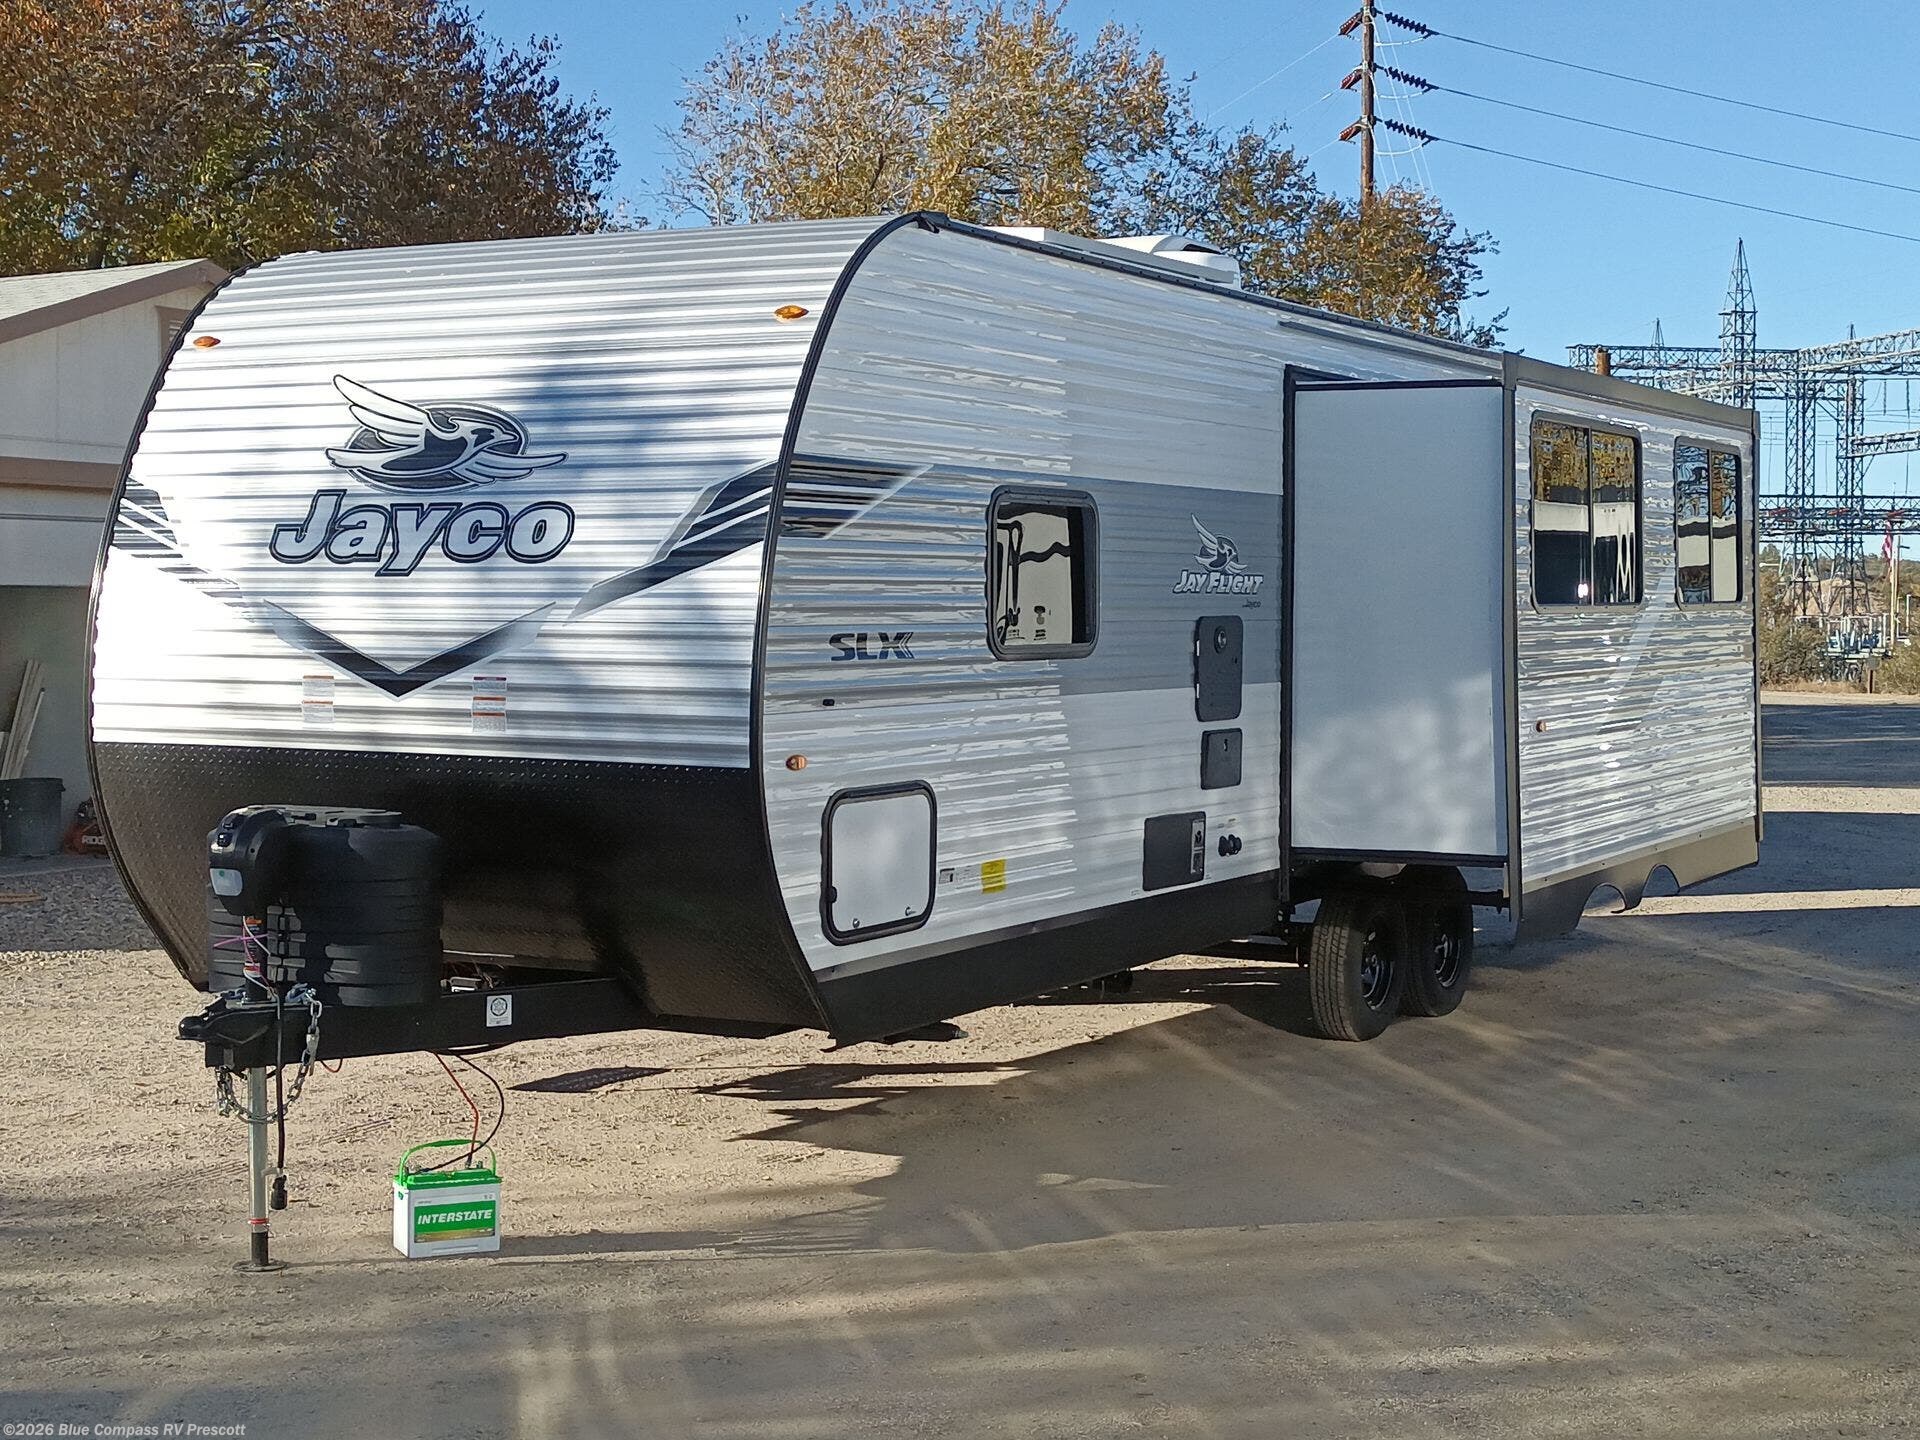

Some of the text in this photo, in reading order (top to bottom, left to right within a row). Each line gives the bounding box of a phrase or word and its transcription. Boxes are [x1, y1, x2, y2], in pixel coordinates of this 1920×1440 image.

[268, 488, 576, 577] Jayco
[1173, 568, 1264, 595] JAY FLIGHT
[829, 631, 915, 661] SLX
[417, 1209, 493, 1225] INTERSTATE
